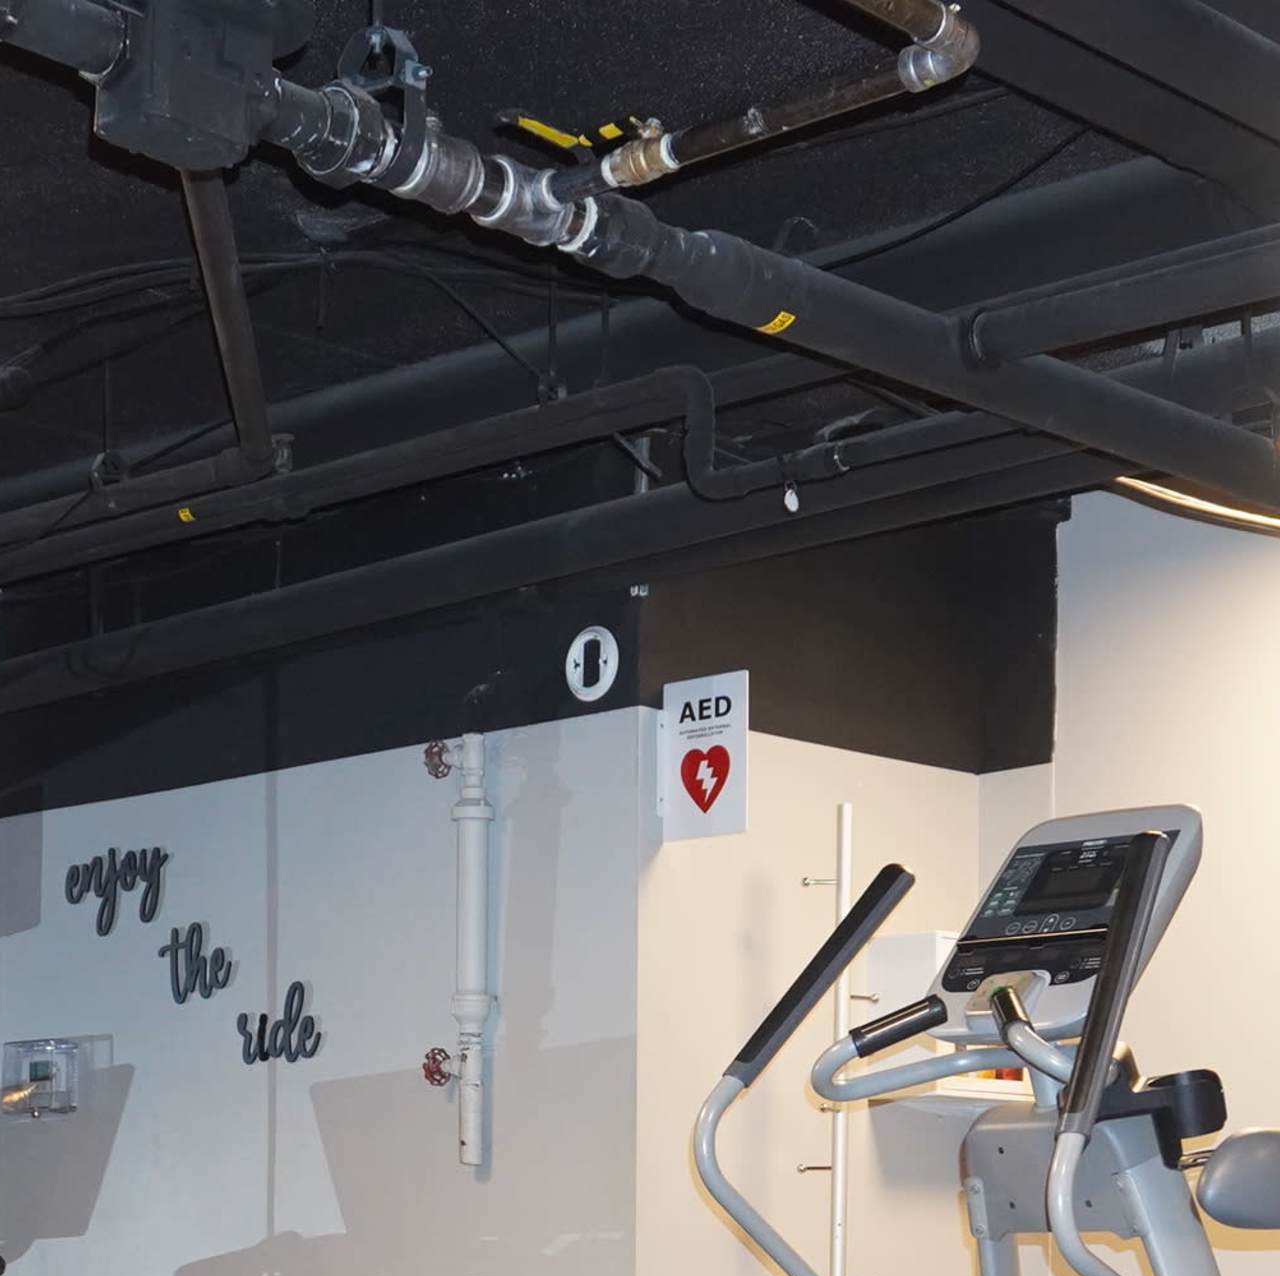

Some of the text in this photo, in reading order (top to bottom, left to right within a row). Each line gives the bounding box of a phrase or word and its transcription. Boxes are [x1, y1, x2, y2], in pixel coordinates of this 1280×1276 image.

[679, 696, 732, 724] AED
[65, 847, 169, 937] enjoy
[158, 922, 231, 1004] the
[237, 981, 322, 1065] ride
